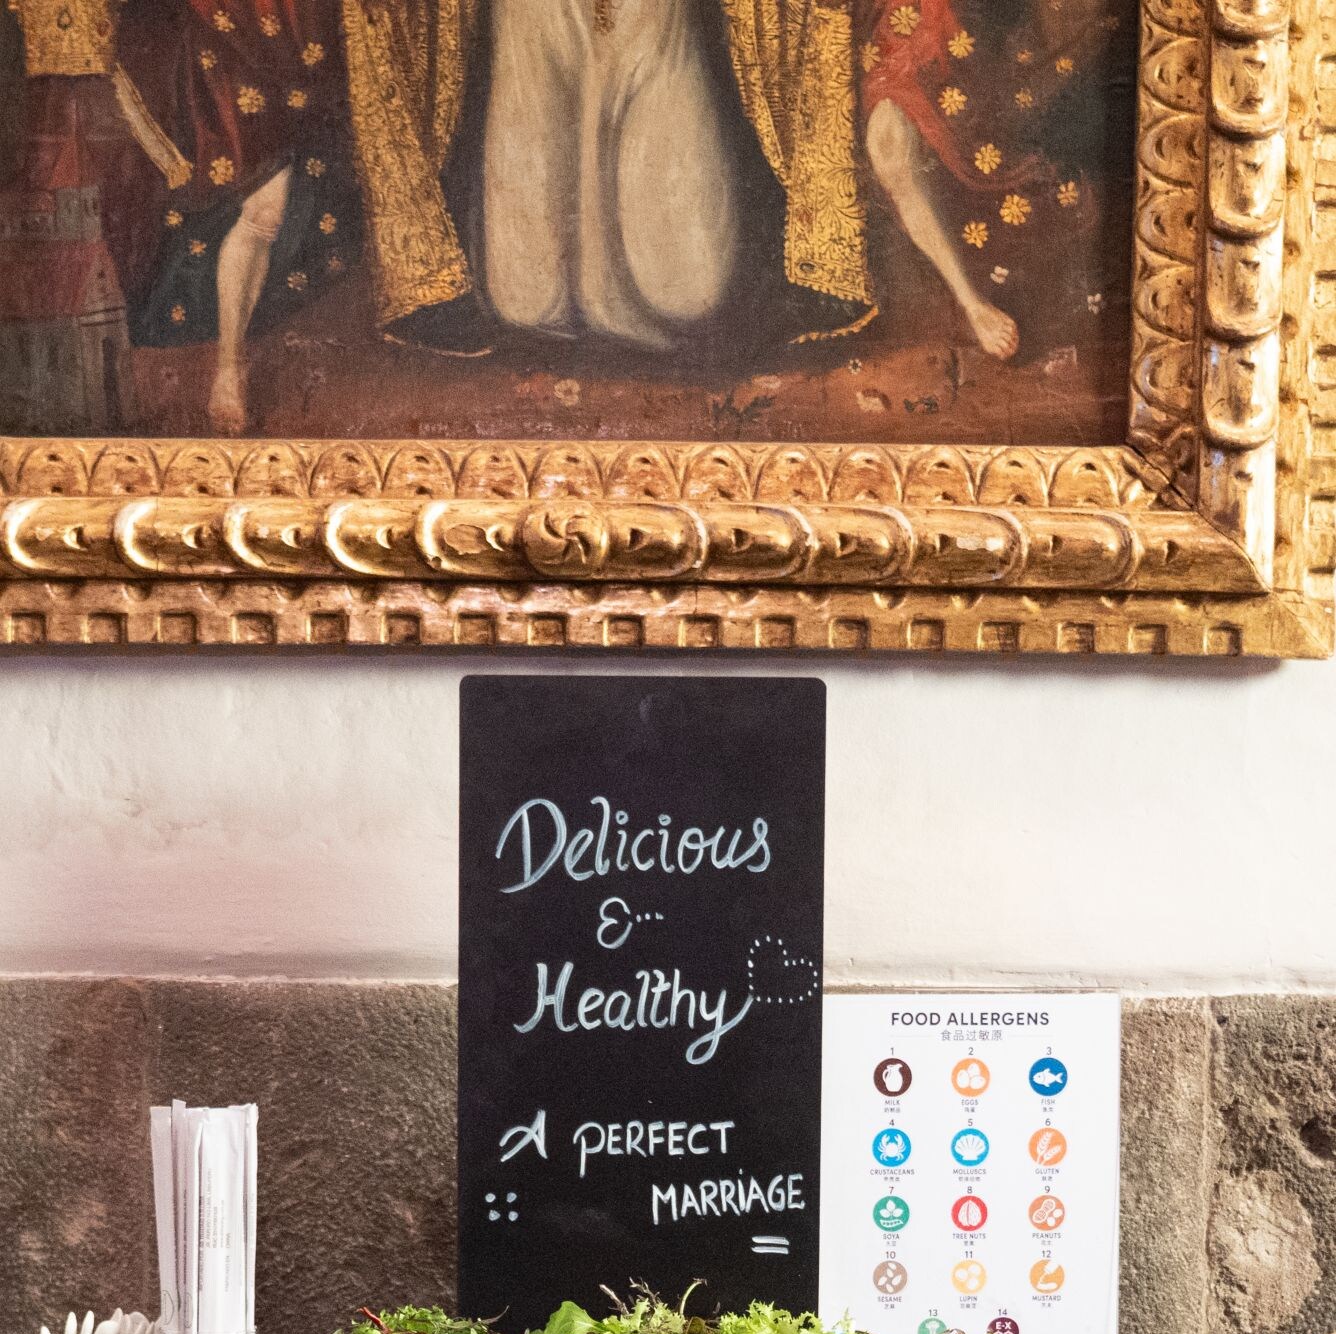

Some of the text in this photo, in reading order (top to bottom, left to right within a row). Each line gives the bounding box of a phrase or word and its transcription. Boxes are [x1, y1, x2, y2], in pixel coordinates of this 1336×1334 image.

[496, 797, 770, 893] Delicious
[514, 962, 754, 1064] Healthy
[891, 1012, 1050, 1026] FOOD ALLERGENS
[941, 1029, 1003, 1041] 食品过敏原
[890, 1047, 895, 1056] 1
[968, 1047, 974, 1055] 2
[1046, 1047, 1052, 1055] 3
[967, 1119, 973, 1127] 5
[1045, 1118, 1051, 1126] 6
[498, 1109, 735, 1177] A PERFECT
[869, 1168, 915, 1176] CRUSTACEANS
[889, 1186, 895, 1194] 7
[967, 1185, 973, 1194] 8
[1044, 1185, 1051, 1193] 9
[886, 1251, 896, 1259] 10
[965, 1250, 973, 1258] 11
[1041, 1250, 1052, 1258] 12
[928, 1309, 938, 1317] 13
[998, 1308, 1008, 1316] 14
[995, 1321, 1012, 1330] E-X
